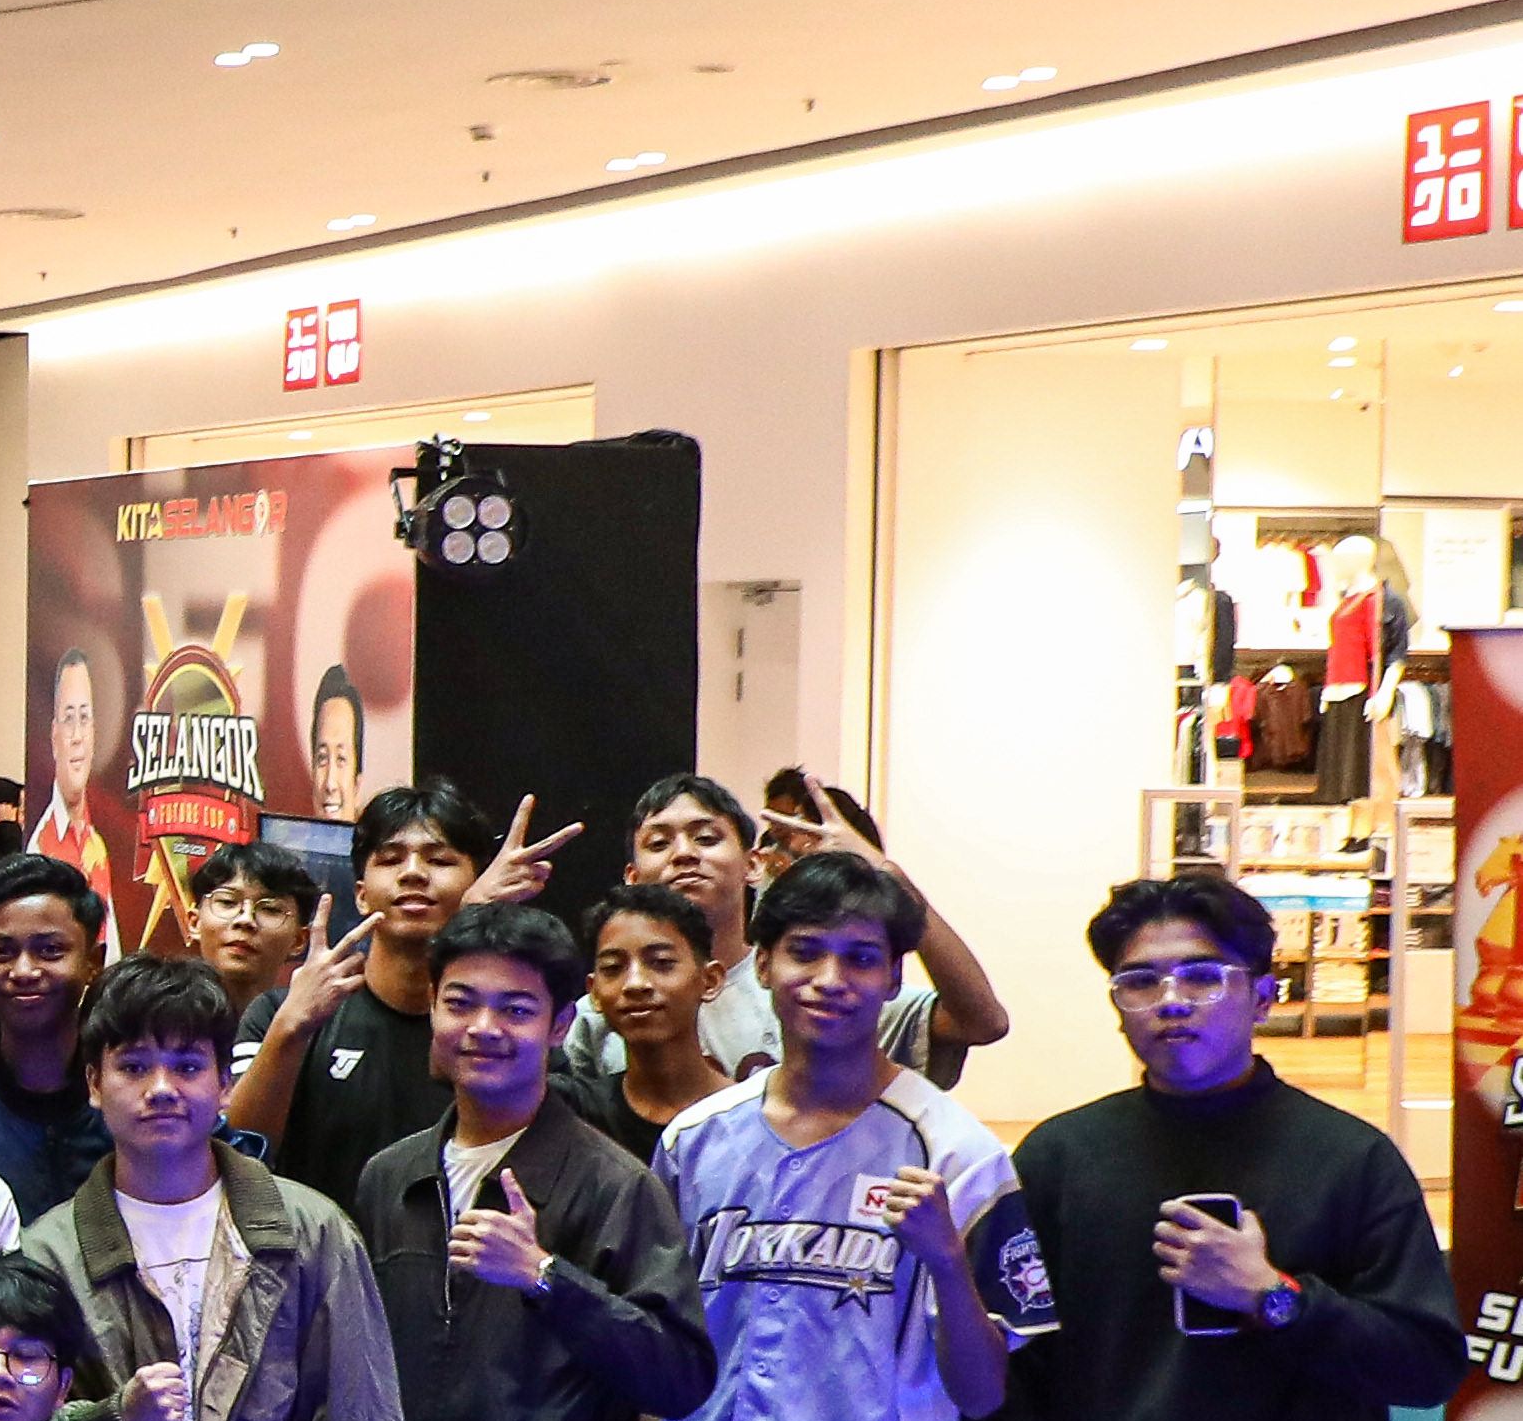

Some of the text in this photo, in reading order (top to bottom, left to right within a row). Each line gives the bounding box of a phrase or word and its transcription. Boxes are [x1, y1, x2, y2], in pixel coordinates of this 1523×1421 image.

[127, 713, 265, 802] SELANGOR
[159, 802, 226, 829] FUTURE CUP
